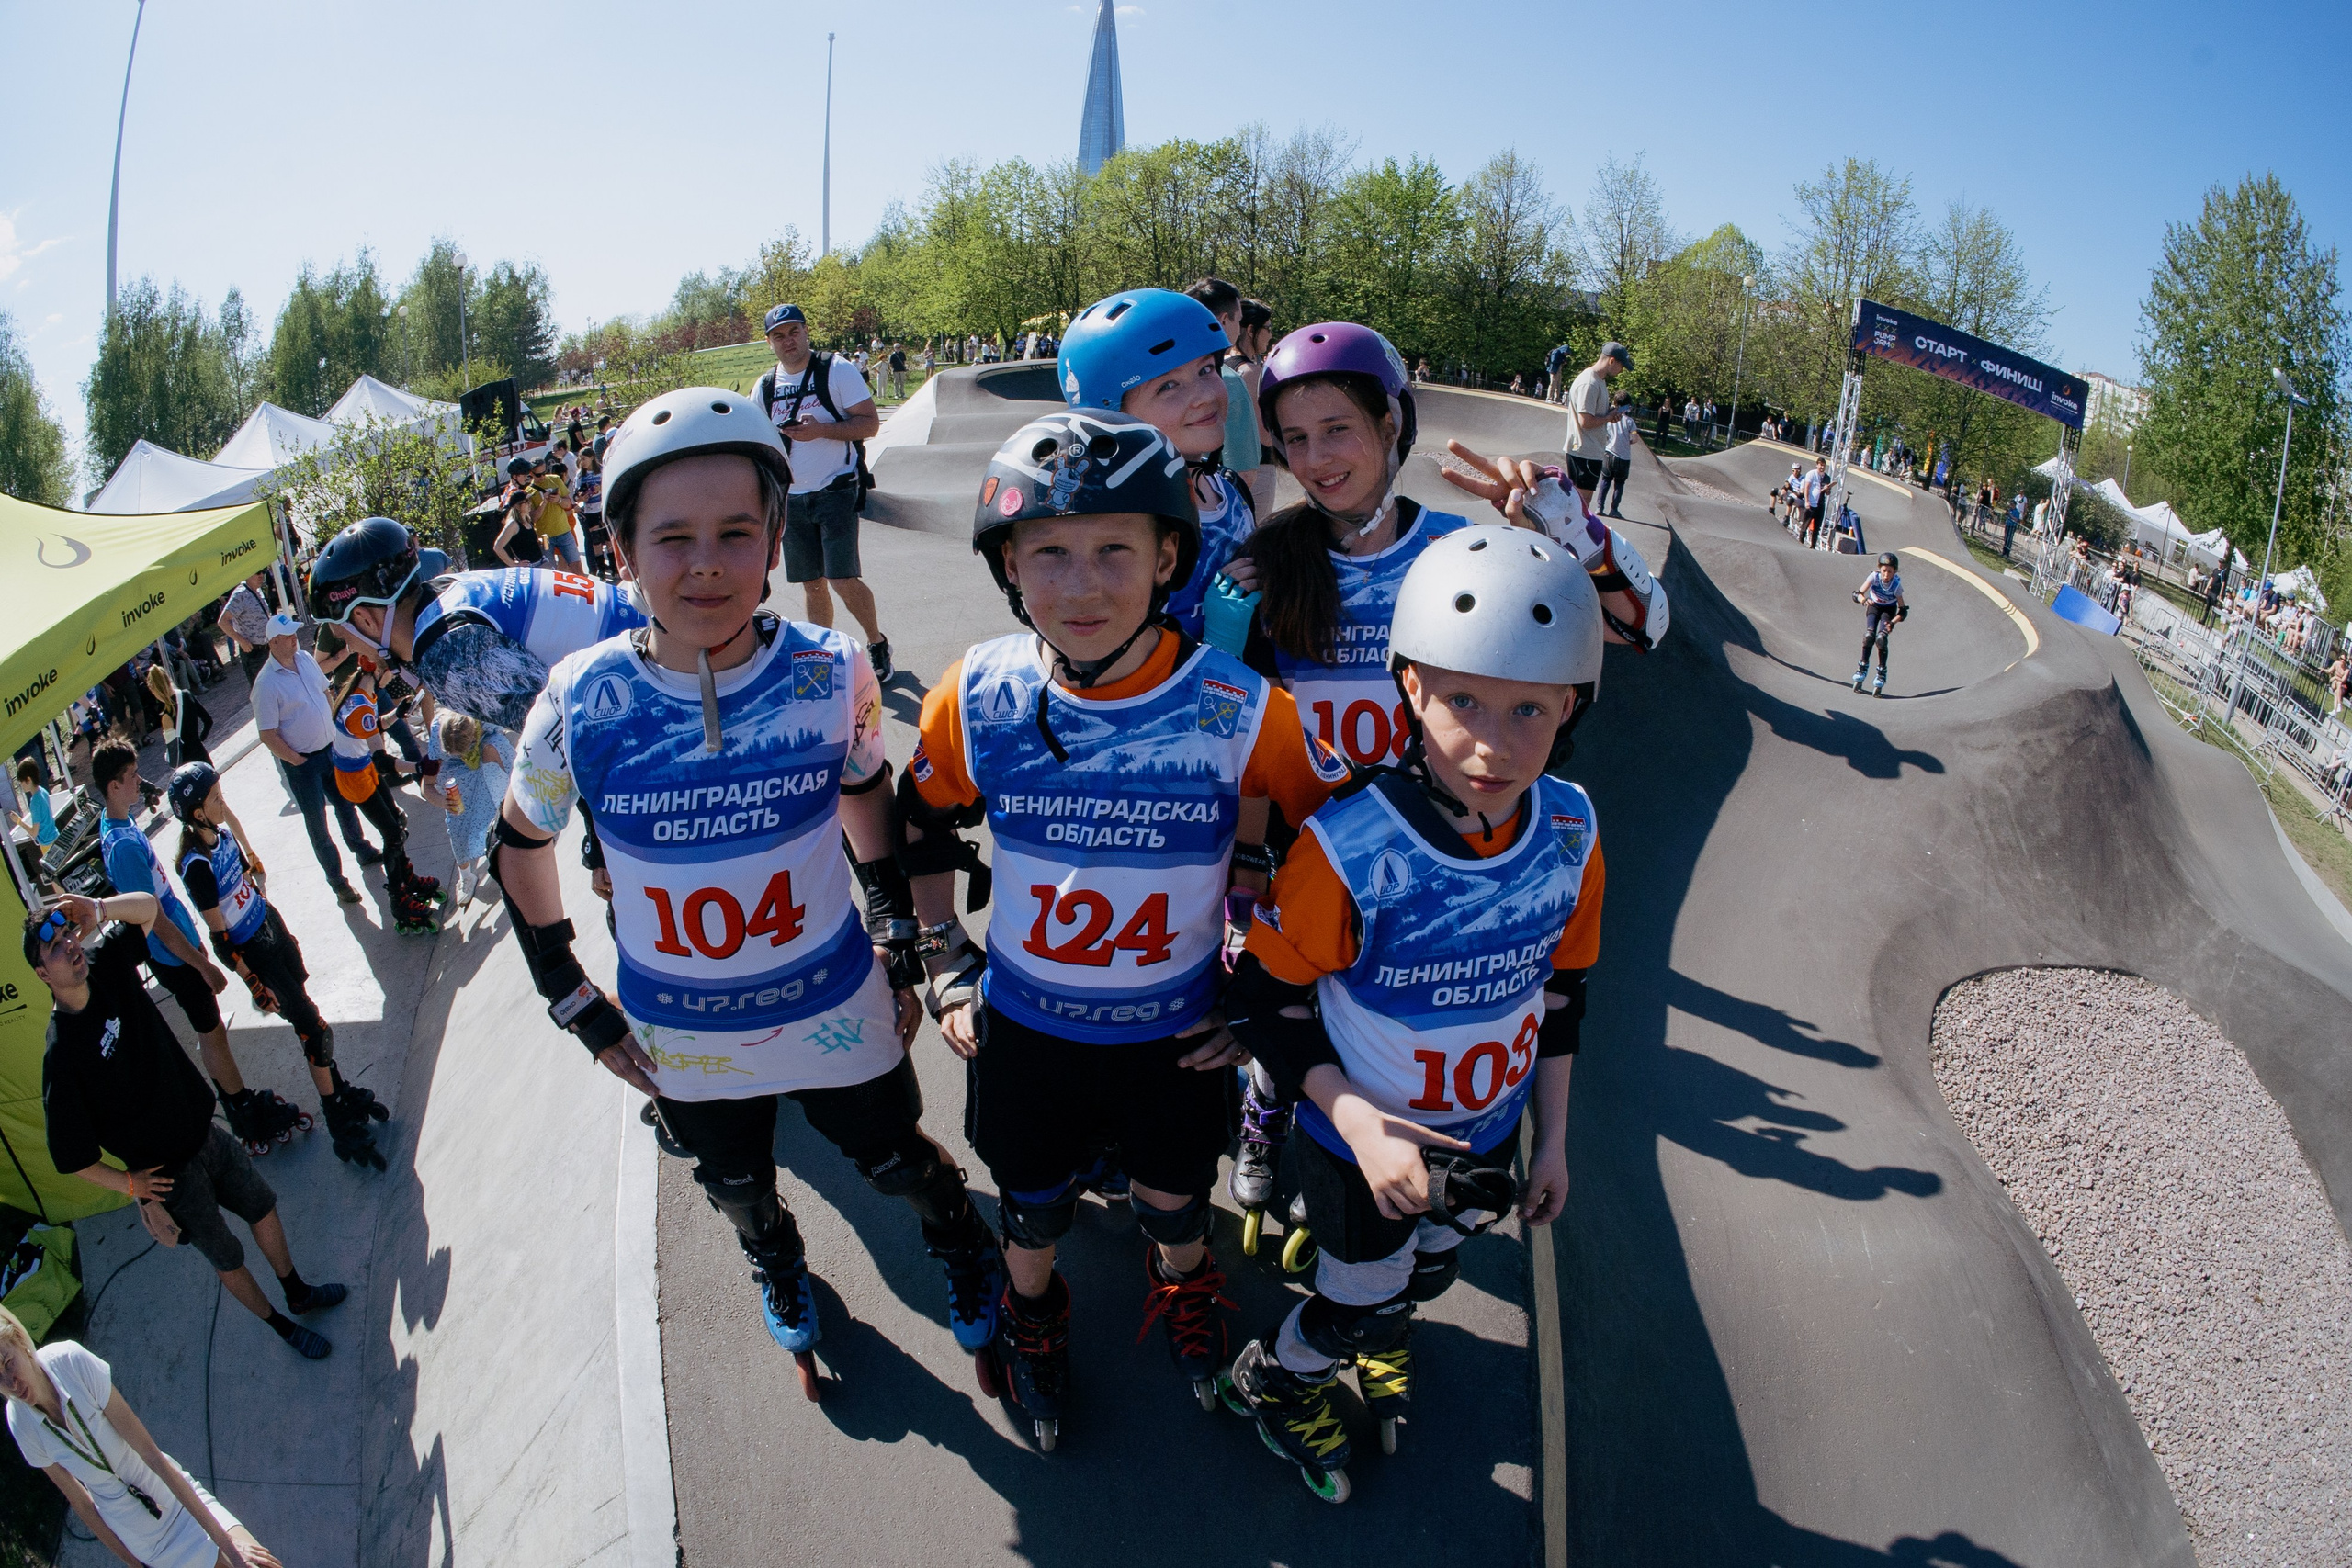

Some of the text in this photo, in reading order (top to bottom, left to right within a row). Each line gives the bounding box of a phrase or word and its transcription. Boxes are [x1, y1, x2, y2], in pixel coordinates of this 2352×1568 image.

[1876, 314, 1898, 326] invoke
[1874, 331, 1896, 342] PUMP
[1914, 335, 2043, 393] СТАРТ ФИНИШ
[1121, 374, 1142, 389] oxelo
[2052, 391, 2078, 410] invoke
[220, 537, 257, 567] invoke
[121, 590, 166, 628] invoke
[328, 586, 357, 603] Chaya
[4, 668, 58, 717] invoke
[594, 705, 623, 718] СШОР
[992, 709, 1019, 720] СШОР
[600, 769, 830, 814] ЛЕНИНГРАДСКАЯ
[999, 794, 1221, 824] ЛЕНИНГРАДСКАЯ
[652, 807, 781, 842] ОБЛАСТЬ
[1046, 823, 1167, 850] ОБЛАСТЬ
[644, 870, 807, 960] 104
[1022, 884, 1180, 968] 124
[1432, 964, 1541, 1007] ОБЛАСТЬ
[1408, 1012, 1540, 1112] 103
